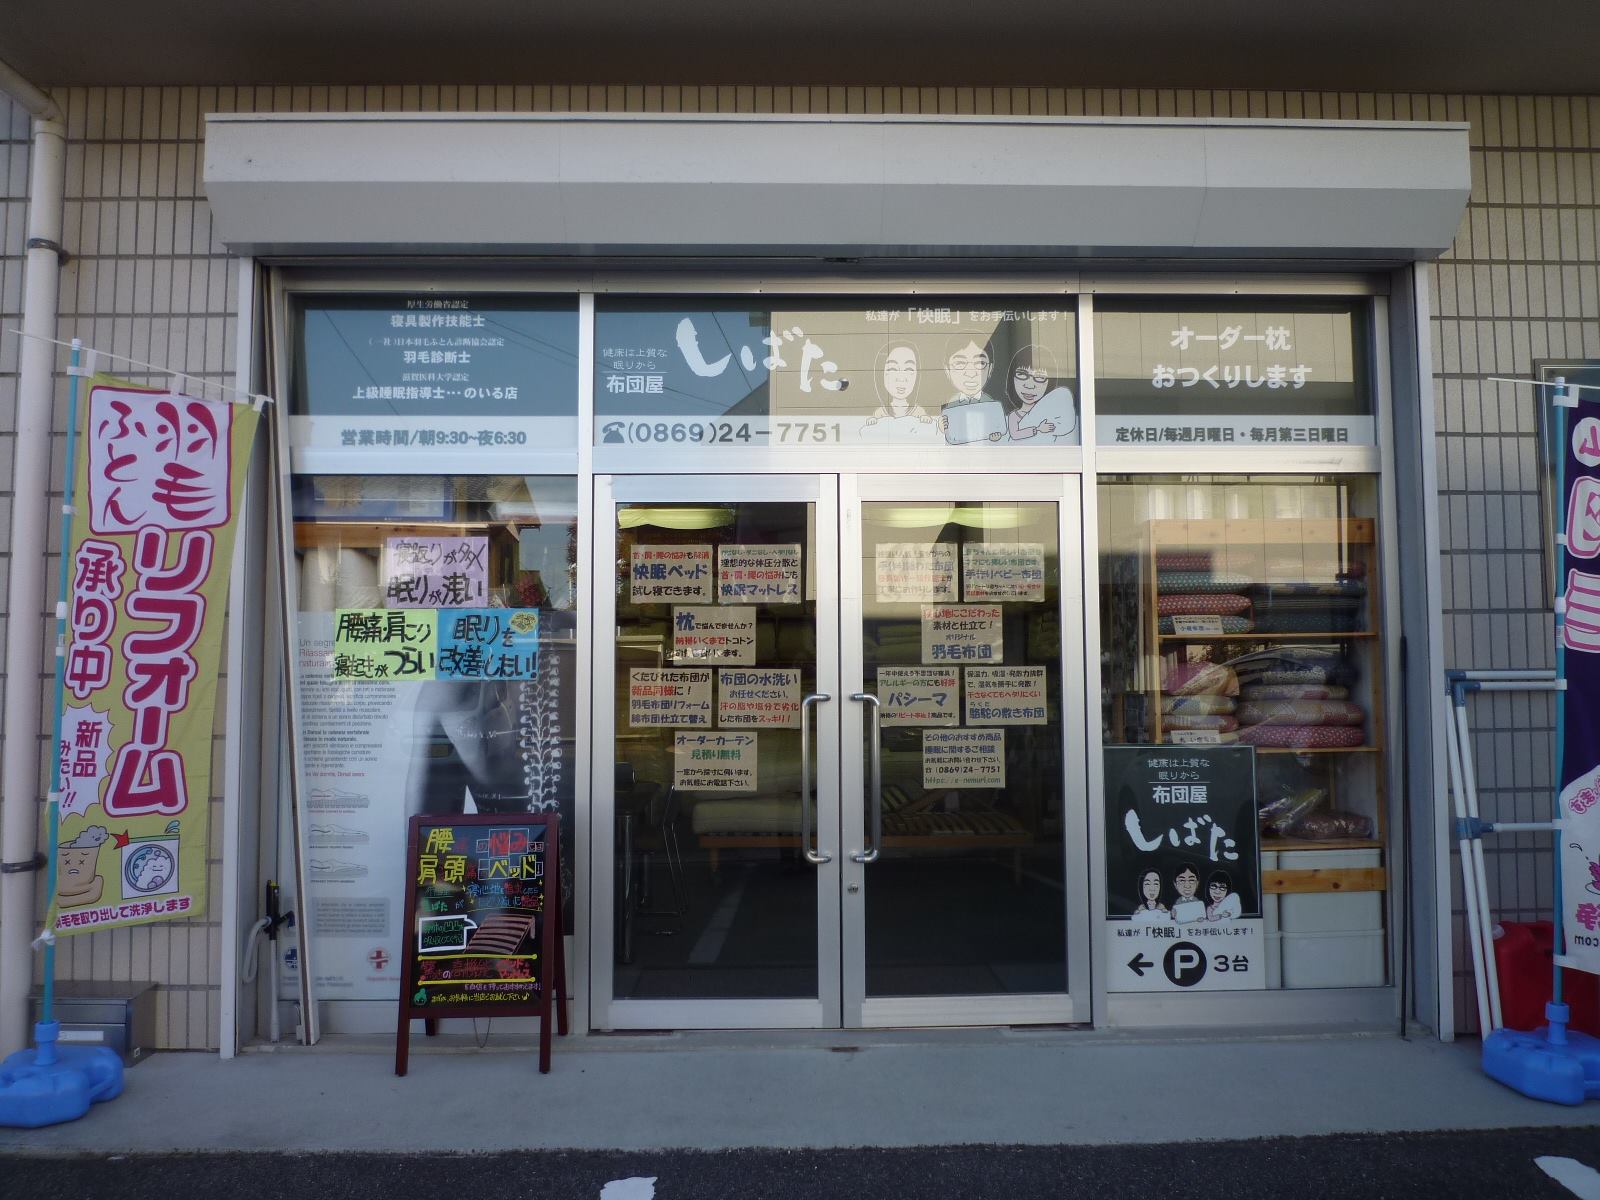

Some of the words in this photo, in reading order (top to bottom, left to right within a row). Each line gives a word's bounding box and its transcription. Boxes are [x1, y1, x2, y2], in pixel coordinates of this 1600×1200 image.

[390, 314, 486, 329] 寝具製作技能士
[1170, 326, 1293, 351] オーダー枕
[403, 350, 472, 364] 羽毛診断士
[602, 347, 669, 359] 健康は上質な
[675, 317, 850, 393] しばた
[612, 360, 657, 371] 眠りから
[1150, 364, 1313, 390] おつくりします
[605, 375, 665, 395] 布団屋
[1115, 426, 1349, 443] 定休日/毎週月曜日・毎月第三日曜日
[98, 400, 149, 528] ふとん
[152, 401, 218, 522] 羽毛
[632, 563, 708, 580] 快眠ベッド
[632, 585, 706, 597] 試し寝できます。
[720, 583, 799, 597] 快眠マットレス
[69, 545, 120, 692] 承り中
[452, 613, 517, 648] 眠りを
[945, 633, 977, 641] オリジナル
[931, 643, 993, 660] 羽毛布団
[109, 530, 209, 810] リフォーム
[631, 671, 710, 683] くたびれた布団が
[720, 672, 798, 687] 布団の水洗い
[631, 685, 692, 697] 新品同様に!
[729, 689, 789, 699] お任せください。
[631, 700, 710, 710] 羽毛布団リフォーム
[888, 691, 948, 707] パシーマ
[676, 735, 754, 746] オーダーカーテン
[72, 720, 103, 778] 新品
[691, 748, 742, 761] 見積り無料
[1147, 758, 1211, 769] 健康は上質な
[1157, 771, 1201, 781] 眠りから
[1152, 785, 1208, 804] 布団屋
[1124, 808, 1240, 862] しばた
[1117, 926, 1254, 939] 私達が「快眠」をお手伝いします!
[1213, 955, 1249, 973] 3台
